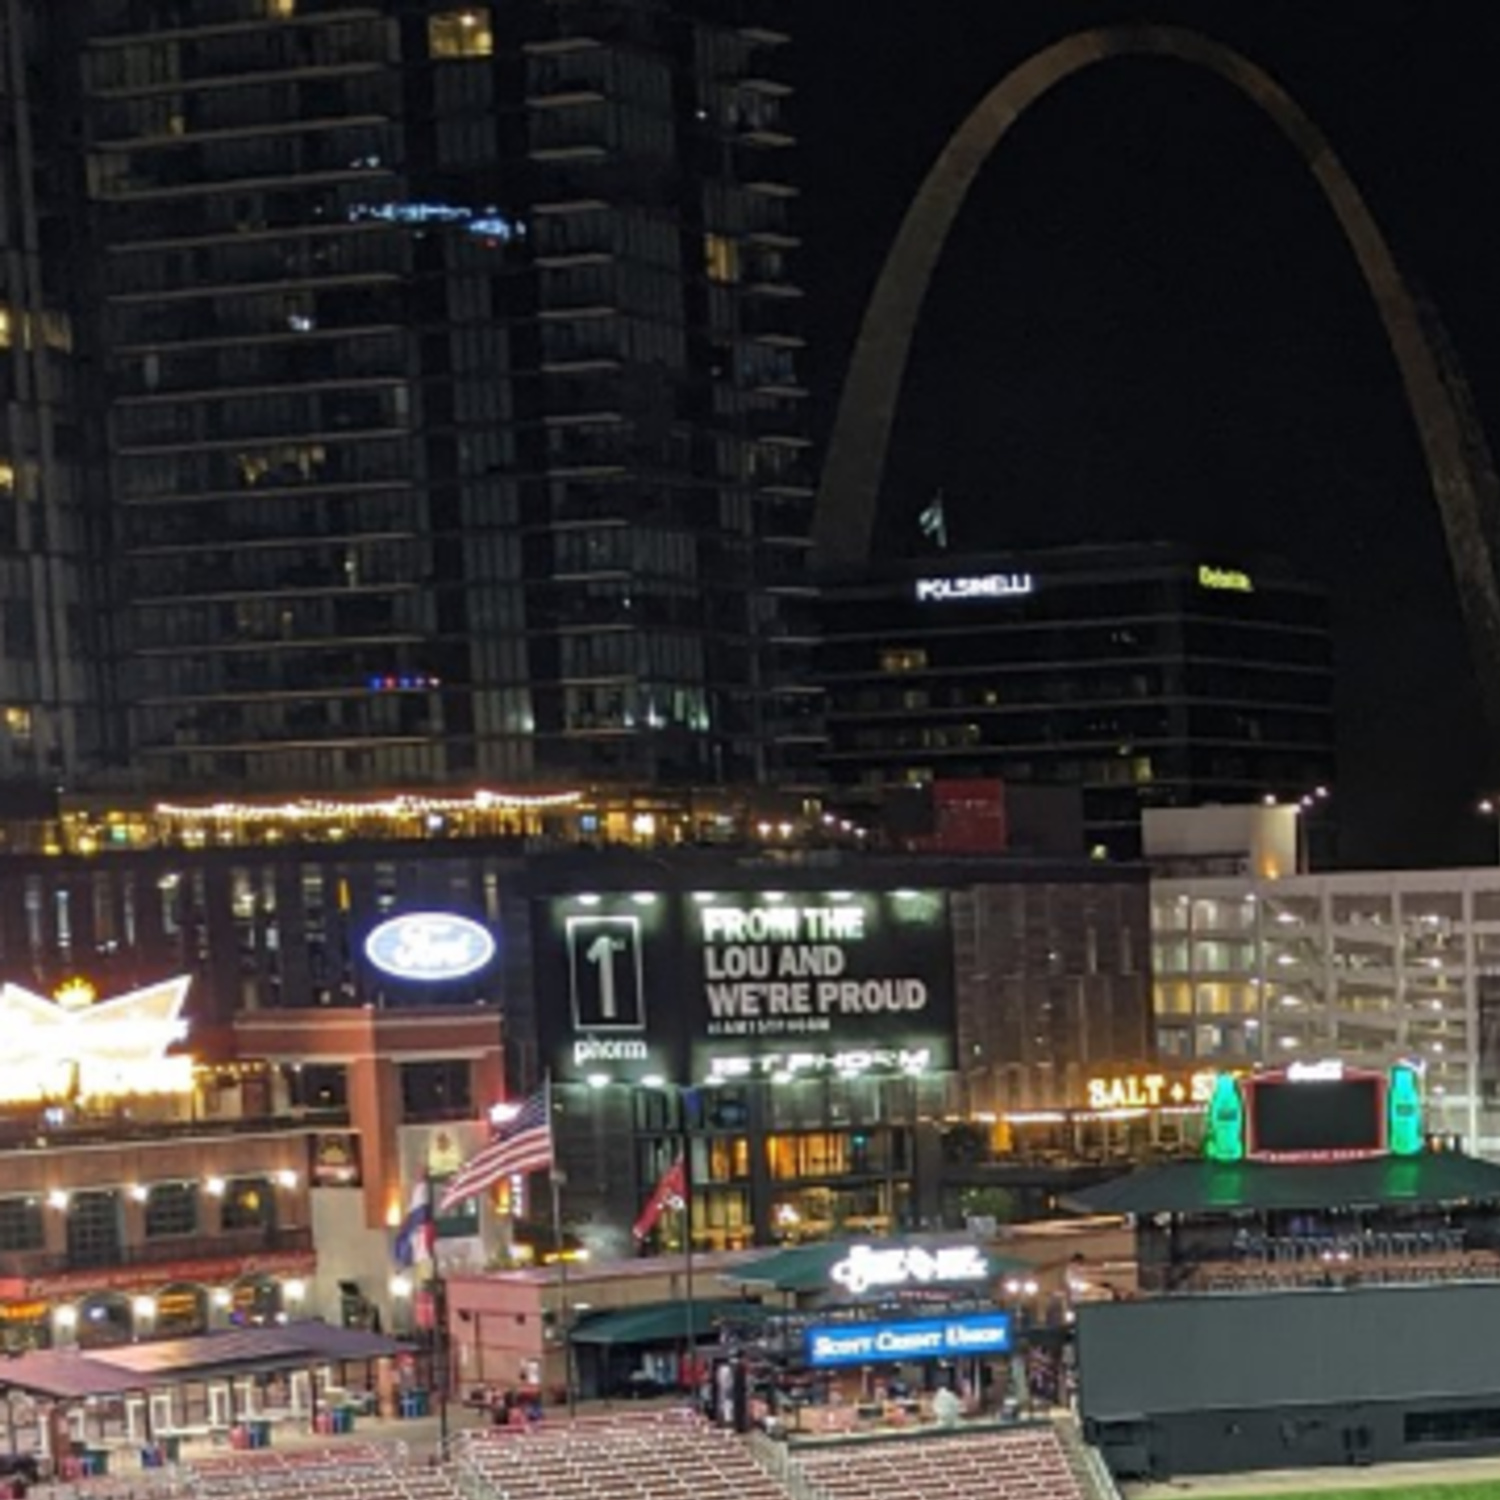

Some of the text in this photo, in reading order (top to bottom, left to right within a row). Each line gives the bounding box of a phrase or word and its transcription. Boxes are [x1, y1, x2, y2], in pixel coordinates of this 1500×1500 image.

[702, 907, 865, 942] FROM THE
[705, 944, 846, 979] LOU AND
[707, 978, 928, 1018] WE'RE PROUD
[574, 1034, 648, 1065] phorm
[1087, 1074, 1164, 1107] SALT
